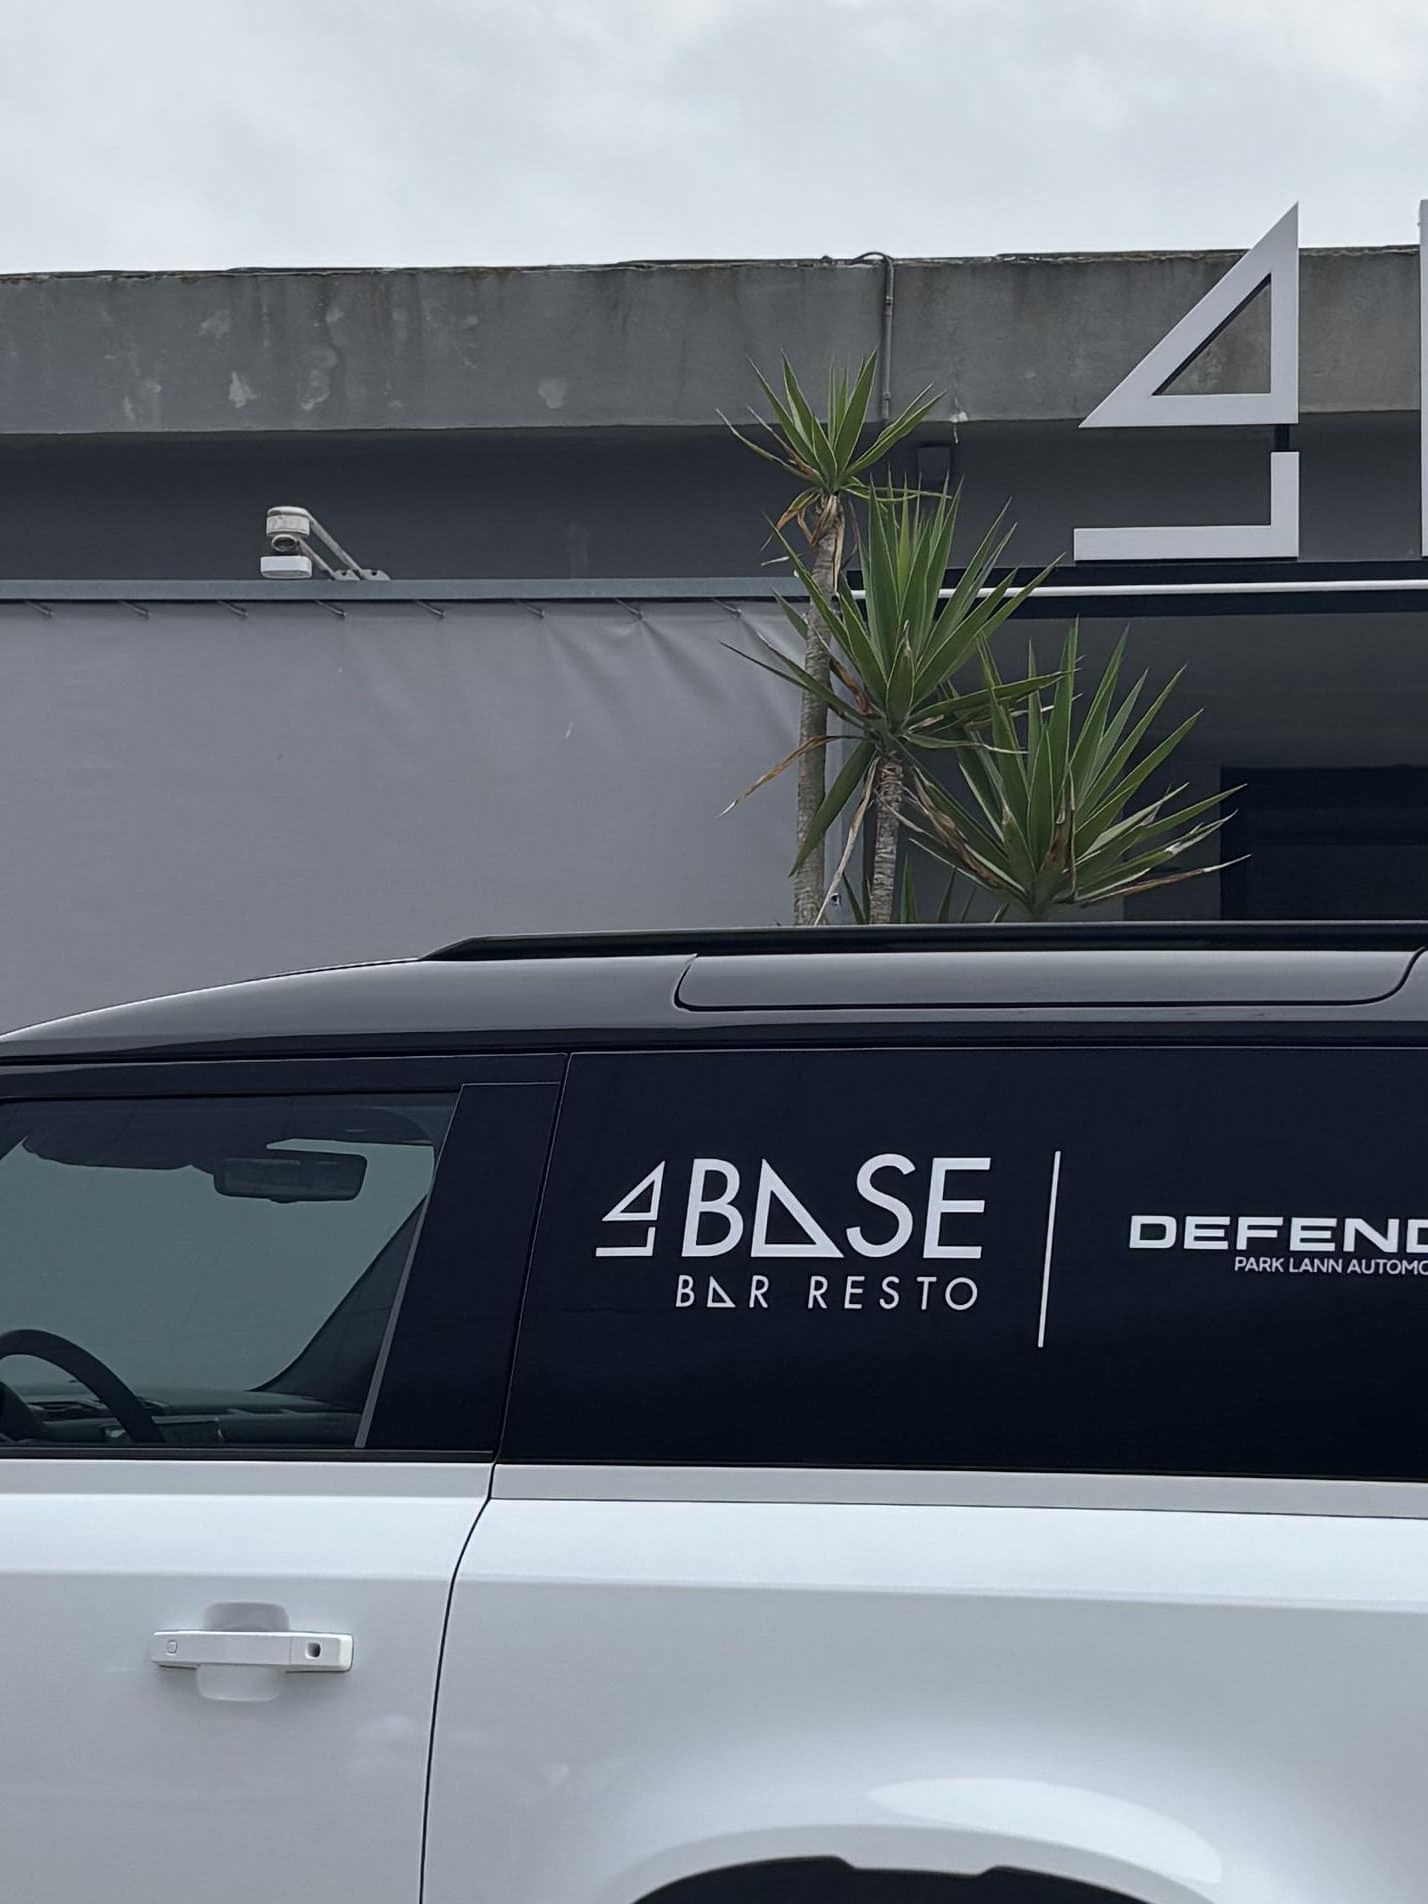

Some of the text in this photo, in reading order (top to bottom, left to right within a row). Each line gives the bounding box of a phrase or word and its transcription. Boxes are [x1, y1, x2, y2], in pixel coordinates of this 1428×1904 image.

[1234, 1256, 1285, 1273] PARK
[1288, 1256, 1344, 1274] LANN
[675, 1274, 978, 1311] BAR RESTO
